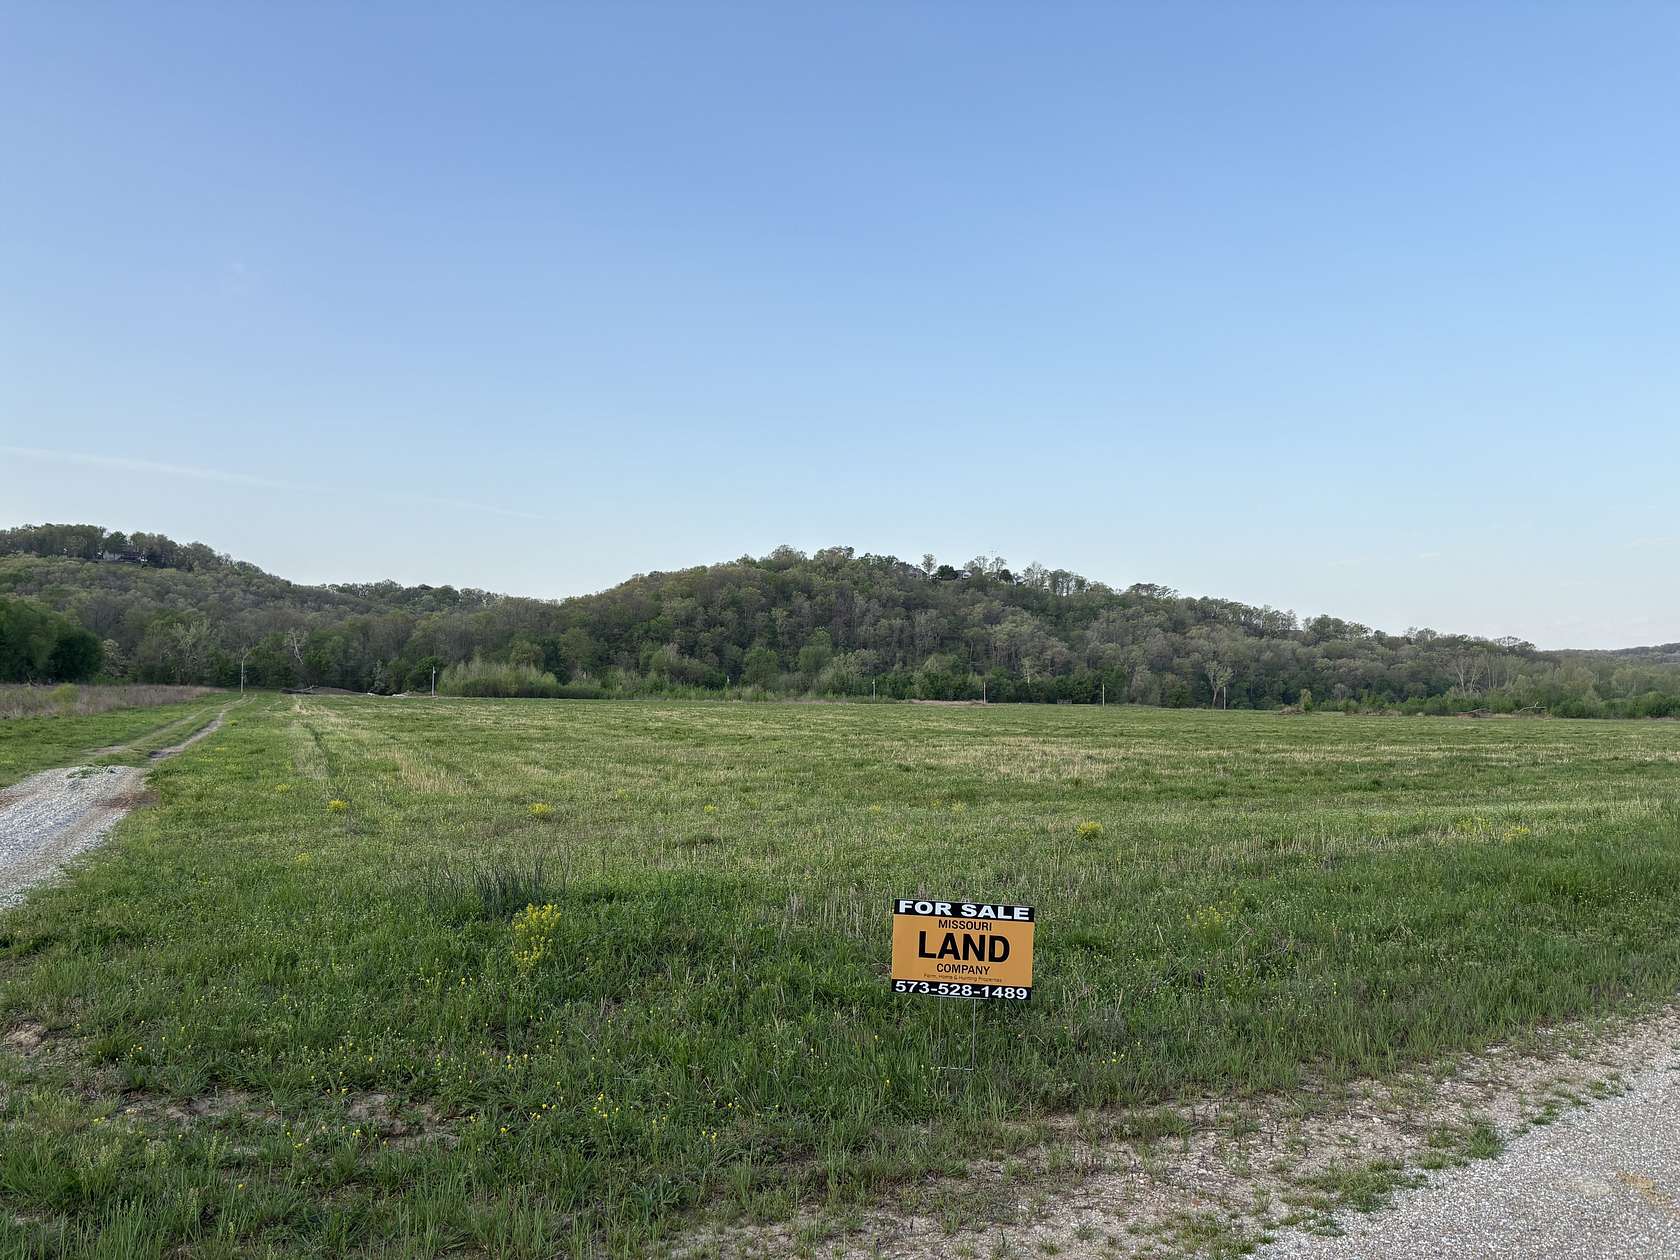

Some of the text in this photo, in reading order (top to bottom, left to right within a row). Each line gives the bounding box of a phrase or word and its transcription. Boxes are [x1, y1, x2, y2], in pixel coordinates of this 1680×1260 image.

[899, 900, 1029, 921] FOR SALE
[938, 919, 992, 931] MISSOURI
[918, 930, 1010, 963] LAND
[936, 963, 991, 975] COMPANY
[895, 980, 1028, 1000] 573-528-1489
